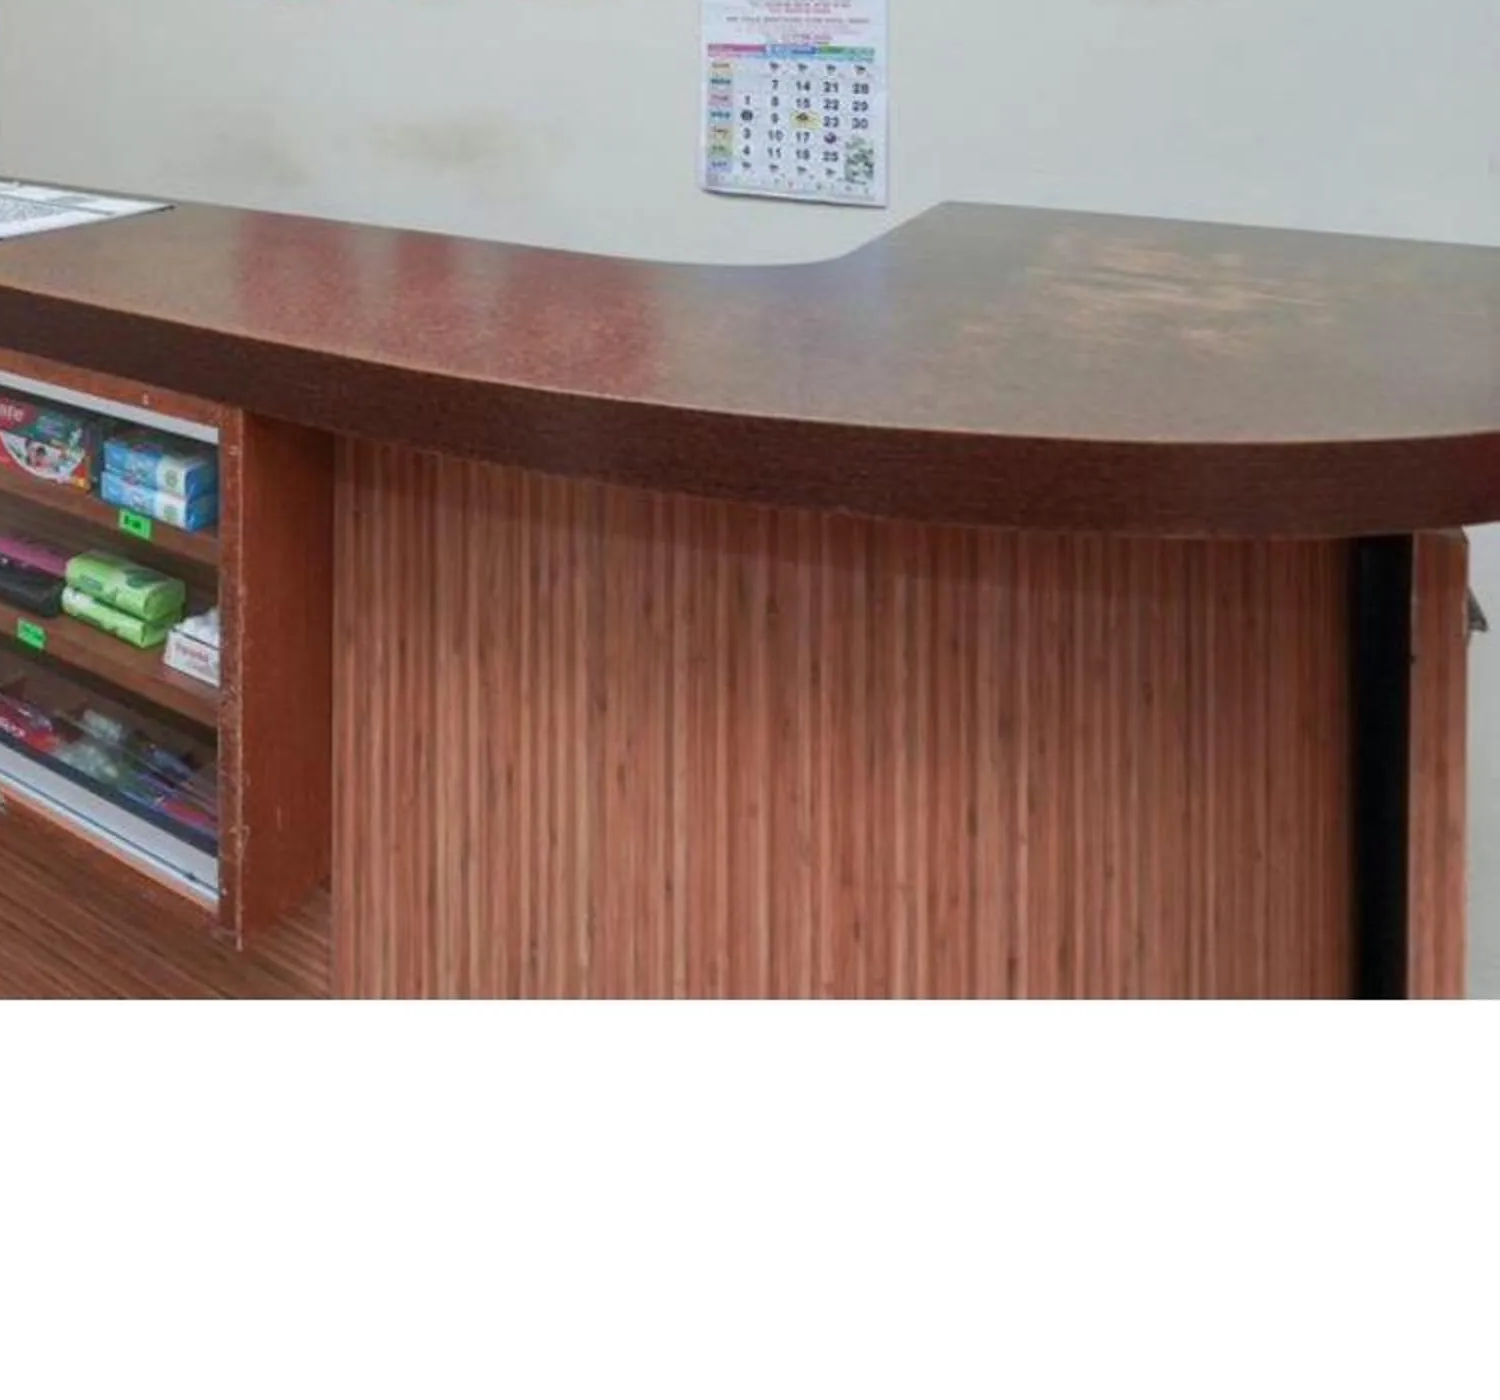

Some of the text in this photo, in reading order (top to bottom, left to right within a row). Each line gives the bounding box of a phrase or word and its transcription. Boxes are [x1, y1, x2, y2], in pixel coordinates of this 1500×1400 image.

[796, 81, 811, 92] 14
[823, 81, 839, 93] 21
[852, 83, 869, 95] 28
[771, 96, 779, 107] 8
[796, 97, 811, 109] 15
[823, 98, 840, 110] 22
[852, 100, 869, 112] 29
[823, 115, 840, 128] 23
[852, 117, 869, 129] 30
[768, 129, 784, 142] 10
[796, 131, 811, 143] 17
[767, 146, 782, 159] 11
[796, 149, 811, 161] 18
[822, 150, 839, 162] 25
